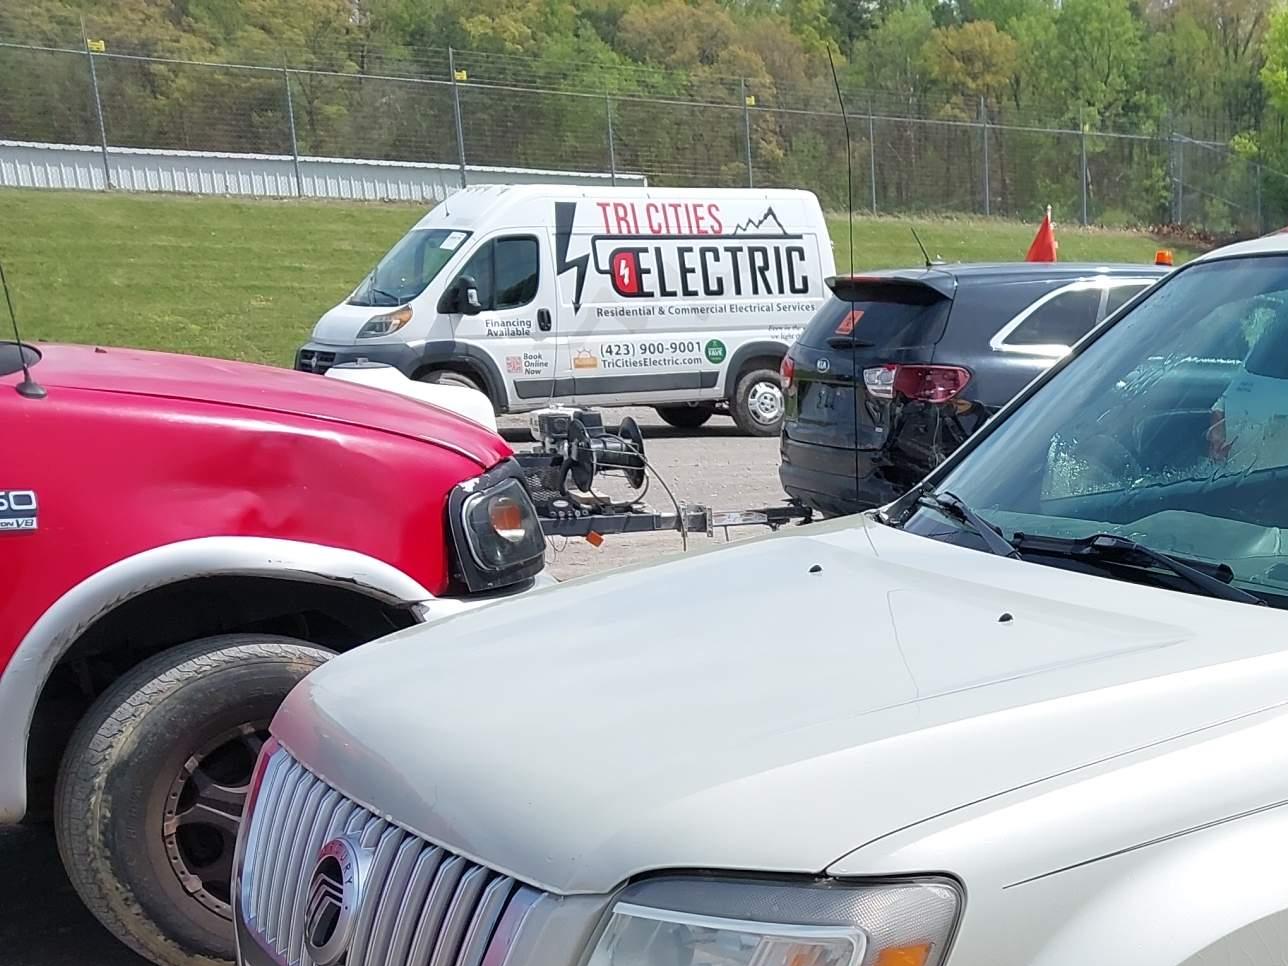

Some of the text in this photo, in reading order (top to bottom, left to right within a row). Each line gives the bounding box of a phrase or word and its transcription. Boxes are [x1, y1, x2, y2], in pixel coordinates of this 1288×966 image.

[596, 202, 723, 234] TRI CITIES
[609, 245, 809, 298] ELECTRIC
[596, 301, 815, 317] Residential & Commercial Electrical Services
[485, 318, 532, 329] Financing
[487, 328, 530, 337] Available
[523, 352, 543, 360] Book
[600, 343, 635, 358] (423)
[639, 341, 702, 355] 900-9001
[600, 356, 702, 369] TriCitiesElectric.com
[15, 518, 34, 528] V8
